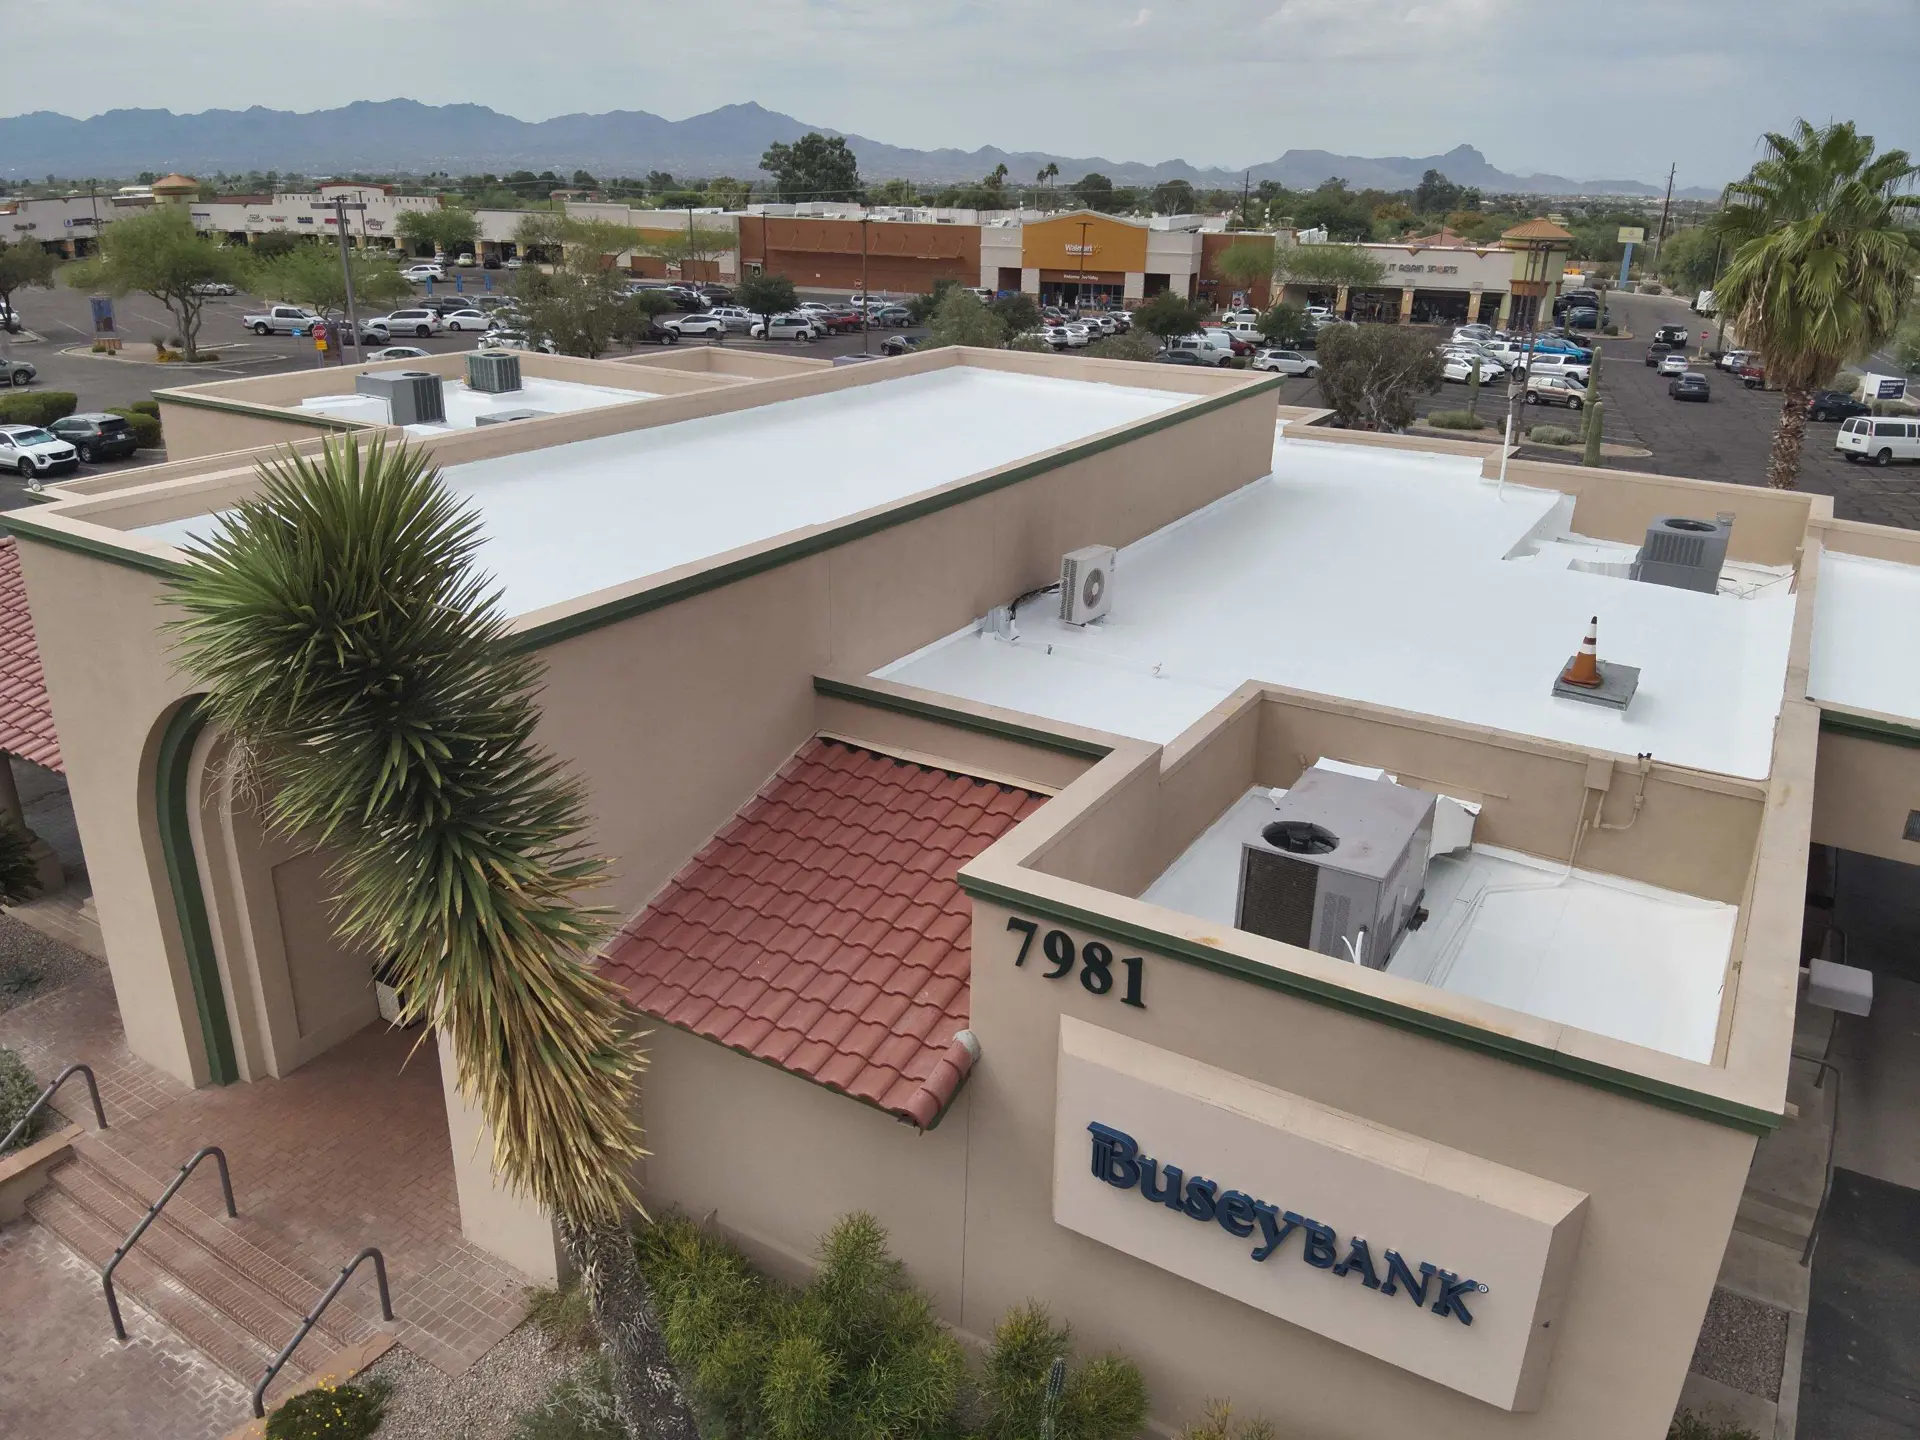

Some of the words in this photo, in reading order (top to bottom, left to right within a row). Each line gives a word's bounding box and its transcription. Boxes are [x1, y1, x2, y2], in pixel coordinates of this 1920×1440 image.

[1065, 244, 1093, 252] Walmart
[1426, 265, 1458, 274] SPORTS
[1006, 916, 1147, 1009] 7981
